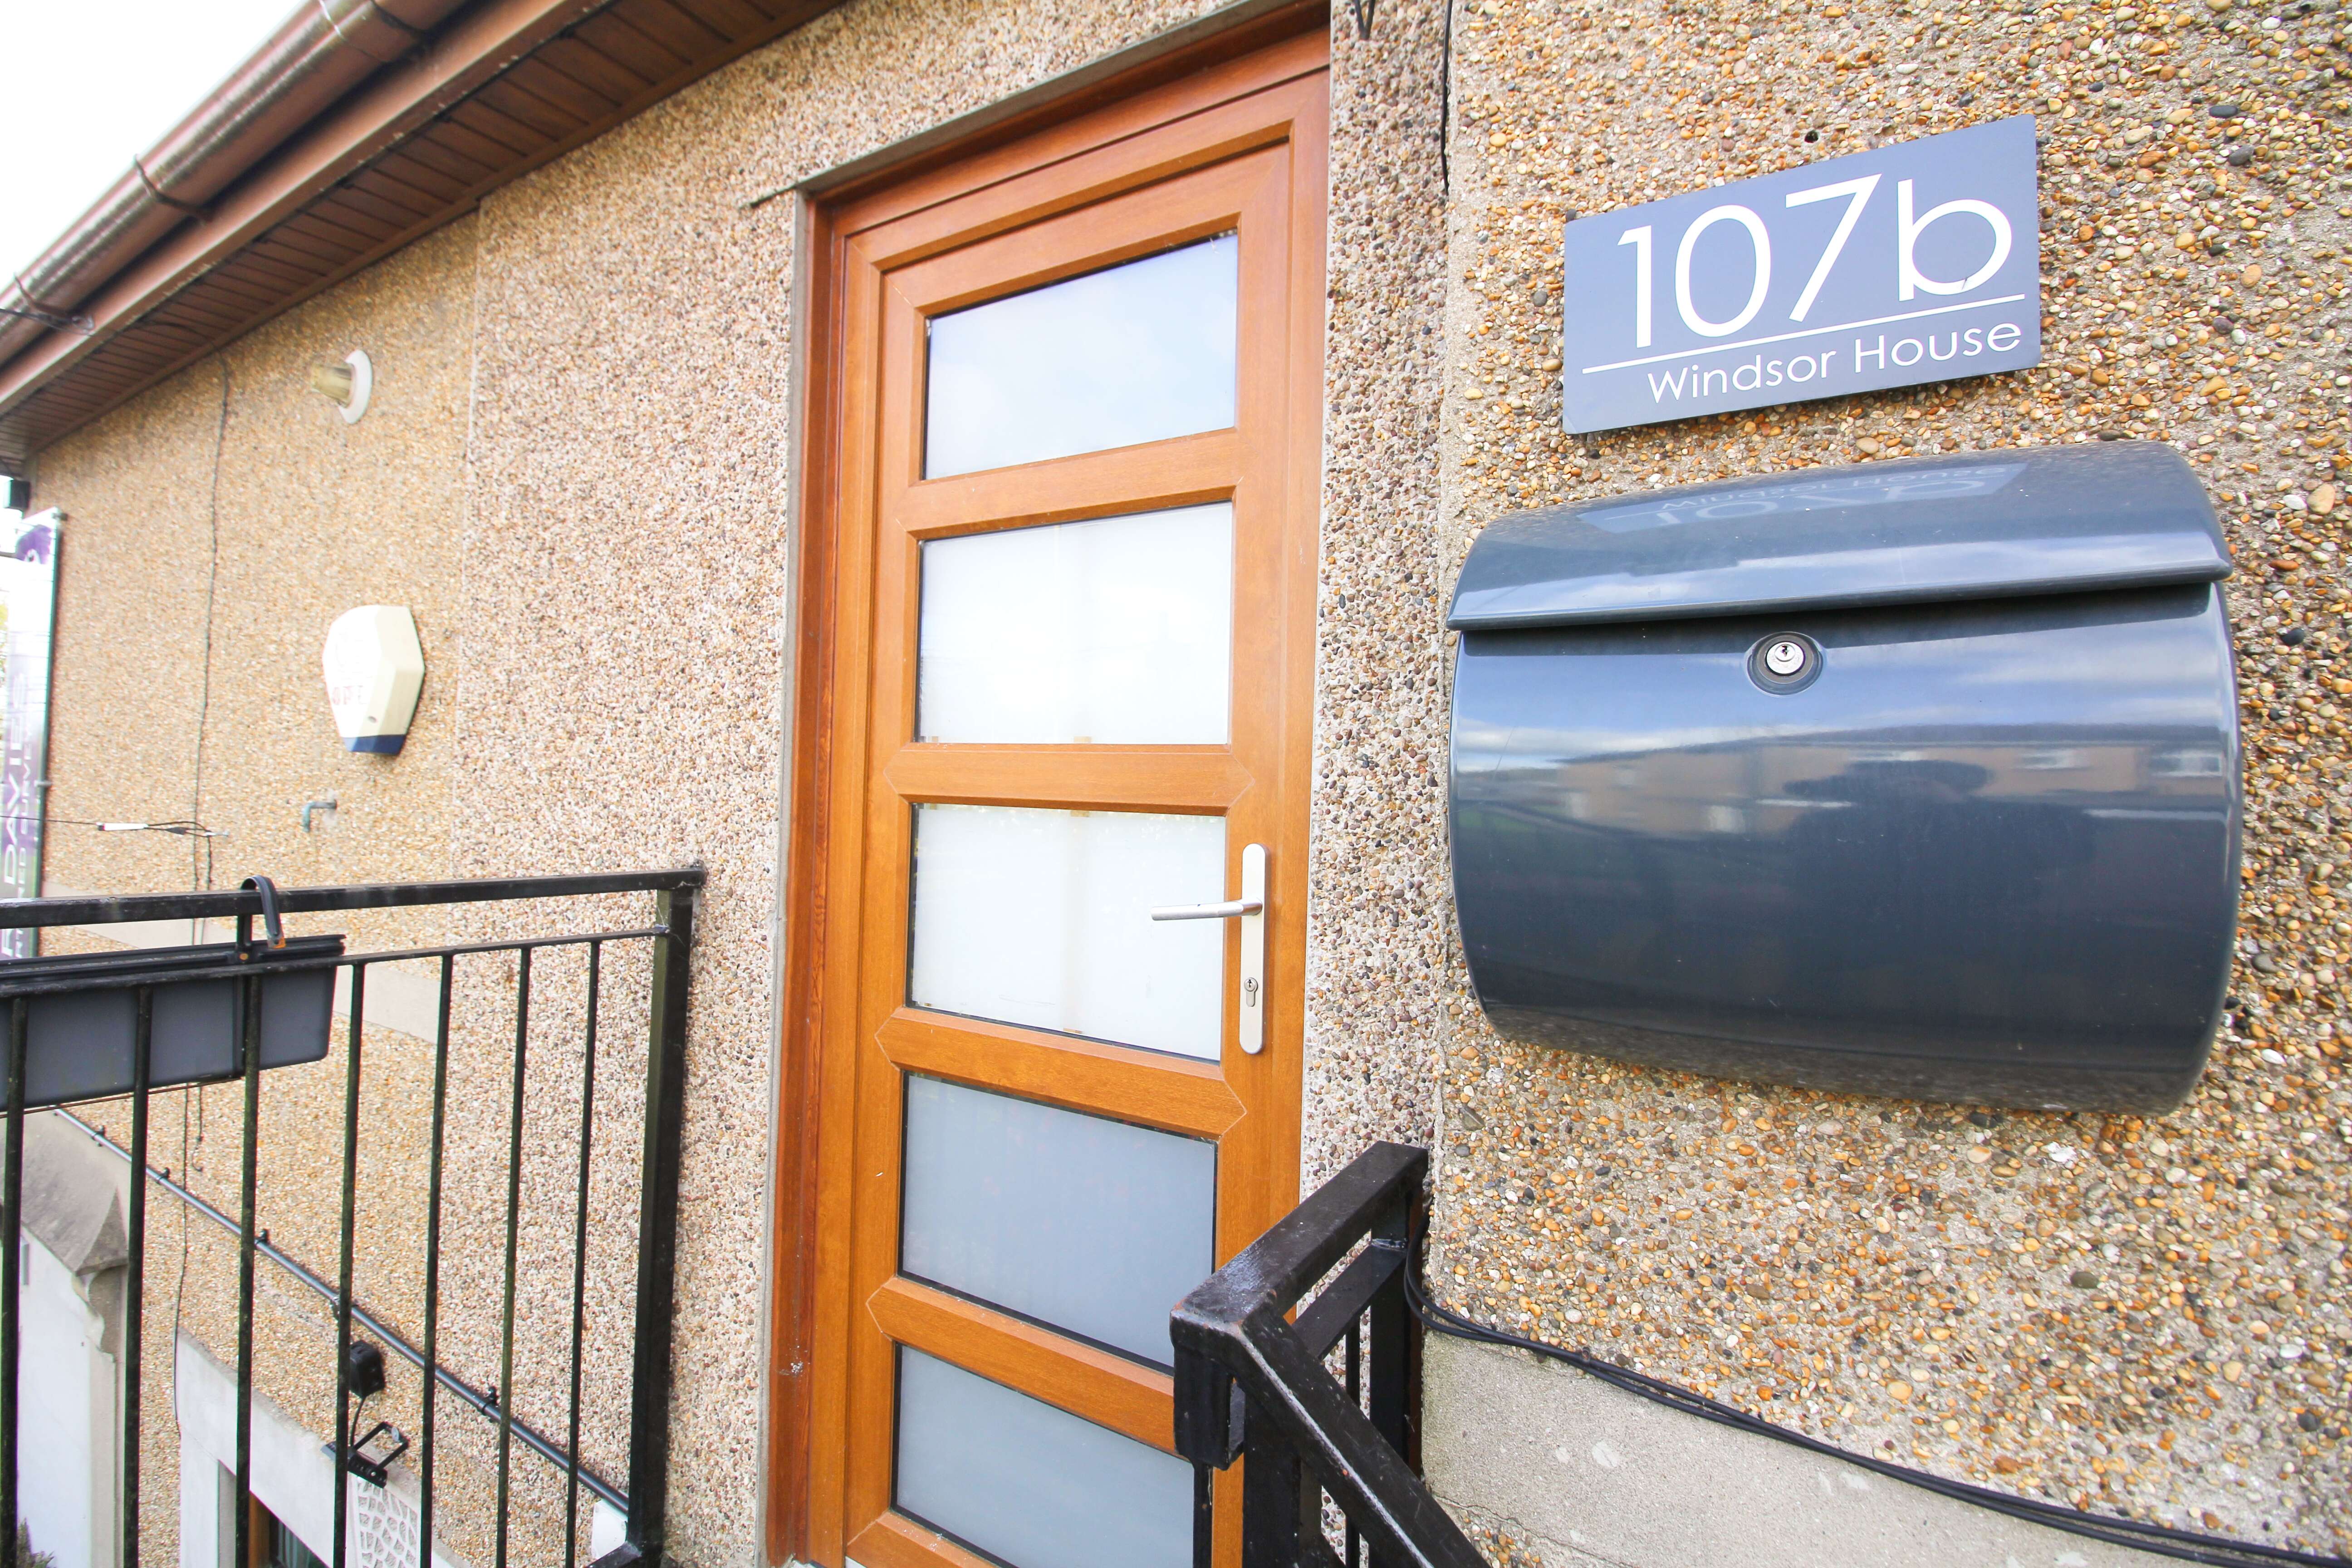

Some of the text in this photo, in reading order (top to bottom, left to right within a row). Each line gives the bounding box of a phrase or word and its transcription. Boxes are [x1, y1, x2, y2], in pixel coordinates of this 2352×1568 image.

[1617, 174, 2012, 348] 107b
[1648, 322, 2022, 403] Windsor House
